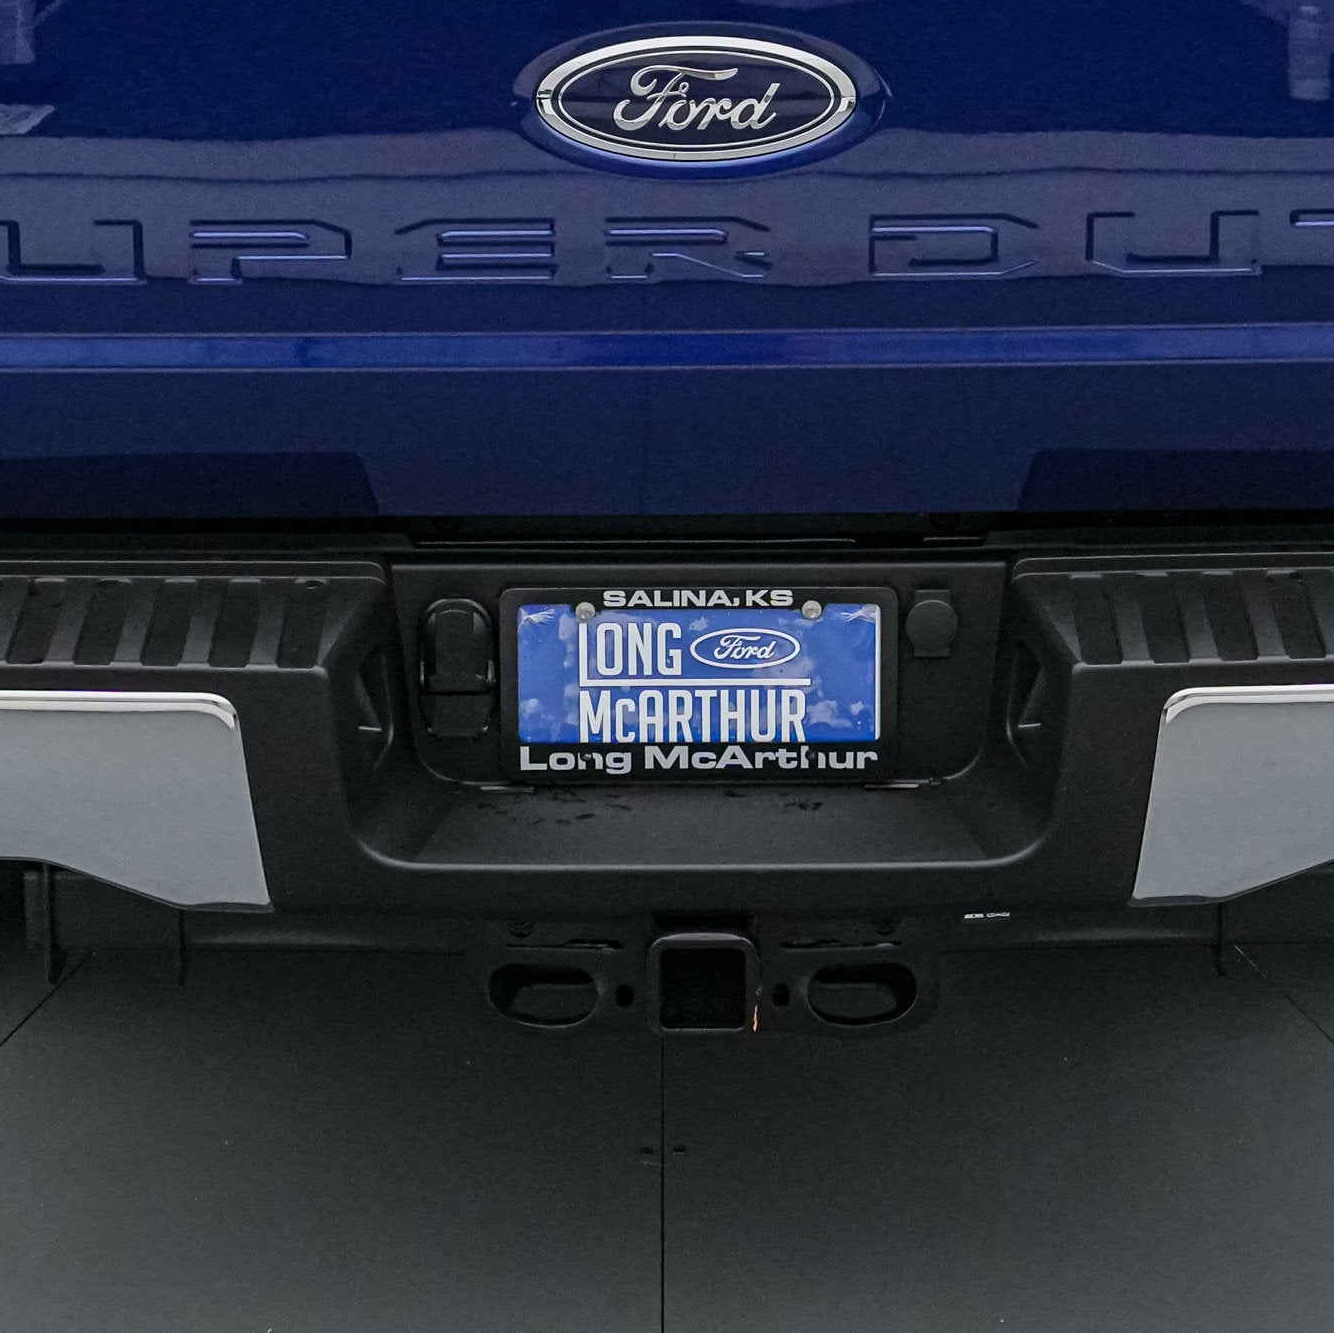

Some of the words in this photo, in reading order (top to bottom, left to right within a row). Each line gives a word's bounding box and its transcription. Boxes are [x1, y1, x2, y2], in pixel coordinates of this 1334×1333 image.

[613, 65, 779, 131] Ford
[603, 589, 740, 607] SALINA,
[746, 589, 793, 607] KS
[579, 622, 682, 686] LONG
[713, 635, 776, 660] Ford
[580, 690, 806, 743] McARTHUR
[520, 746, 632, 775] Long
